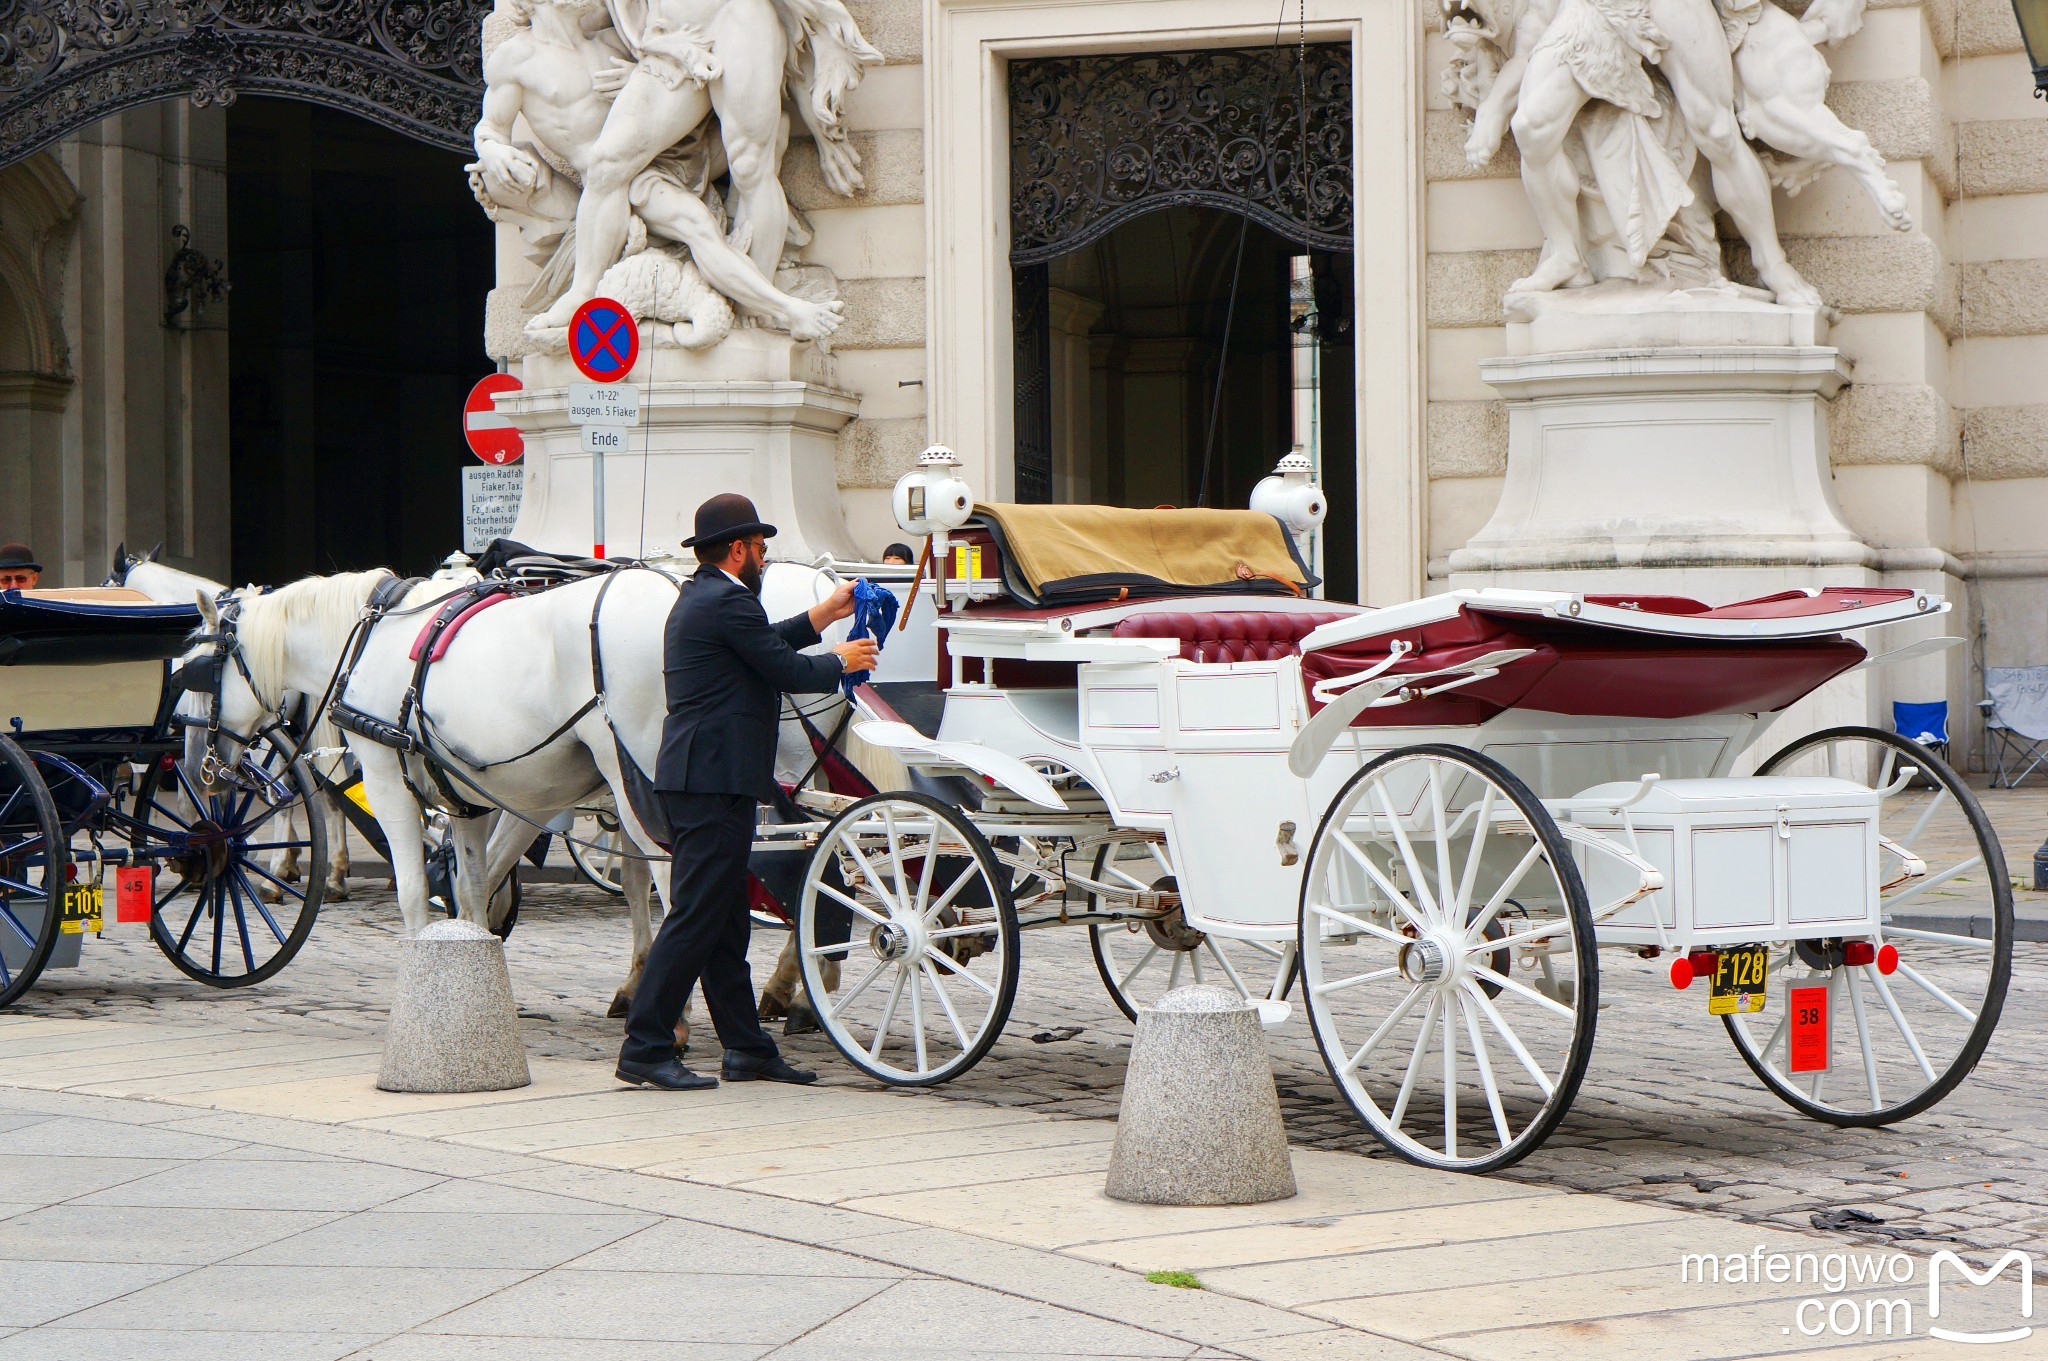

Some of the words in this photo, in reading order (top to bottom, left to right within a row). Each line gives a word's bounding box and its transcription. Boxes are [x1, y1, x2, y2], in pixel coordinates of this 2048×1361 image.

[571, 406, 603, 418] ausgen.
[605, 406, 611, 416] 5
[613, 406, 637, 418] Fiaker
[592, 431, 619, 446] Ende
[124, 880, 143, 892] 45
[1716, 951, 1764, 987] F128
[1798, 1008, 1819, 1026] 38
